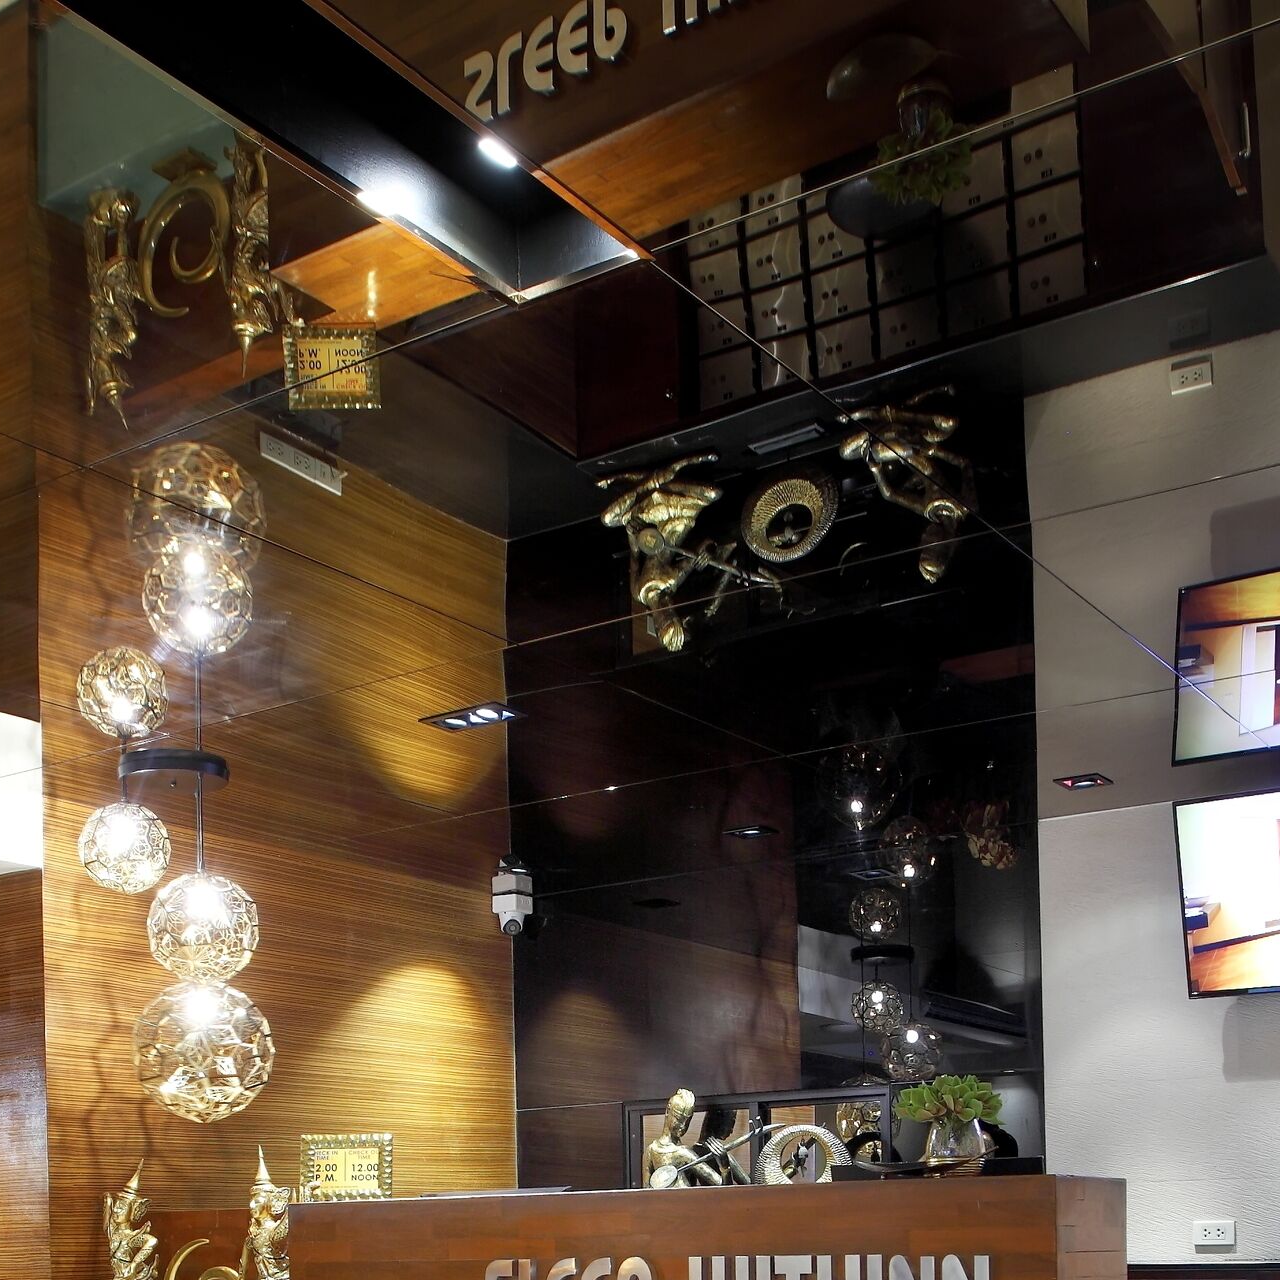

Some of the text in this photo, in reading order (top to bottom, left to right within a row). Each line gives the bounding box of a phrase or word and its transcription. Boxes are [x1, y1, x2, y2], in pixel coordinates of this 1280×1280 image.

[315, 1163, 338, 1172] 2.00
[351, 1163, 379, 1172] 12.00
[315, 1174, 338, 1182] P.M.
[351, 1174, 379, 1182] NOON
